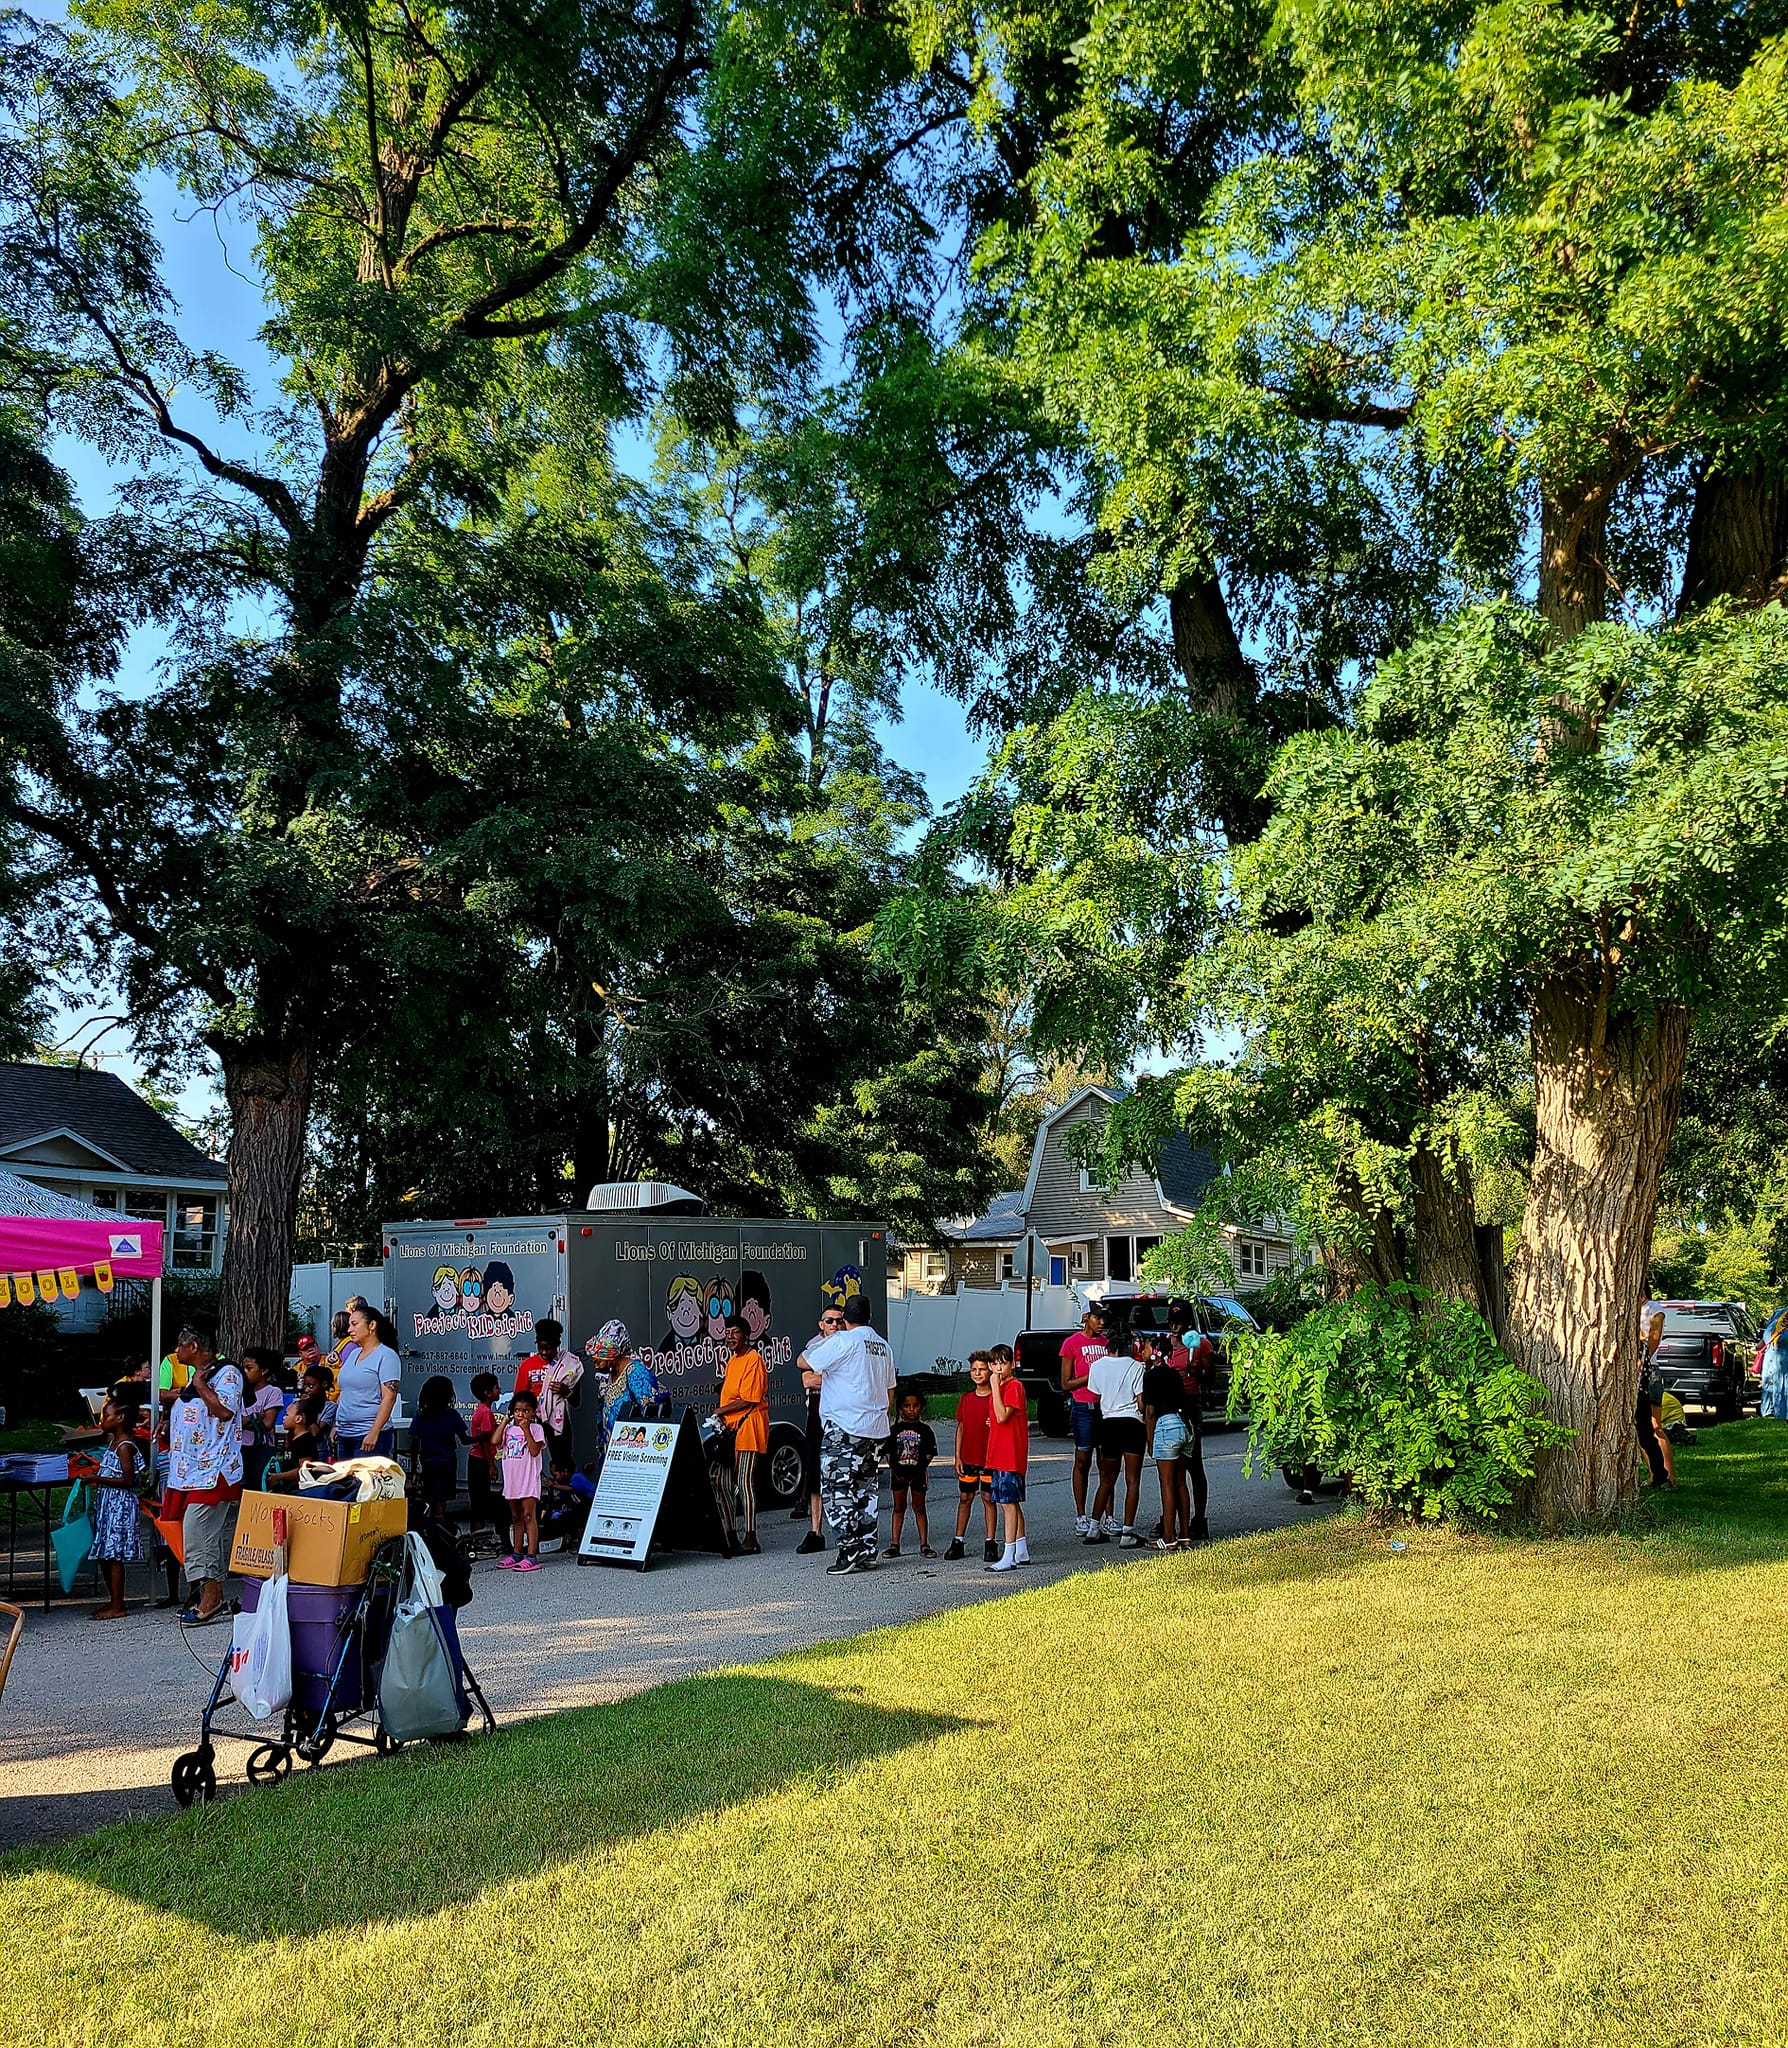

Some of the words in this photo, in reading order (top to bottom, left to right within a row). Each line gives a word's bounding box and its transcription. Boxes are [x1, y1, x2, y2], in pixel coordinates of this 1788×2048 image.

[400, 1244, 426, 1258] Lions
[428, 1244, 440, 1257] Of
[442, 1244, 486, 1259] Michigan
[490, 1240, 548, 1256] Foundation
[615, 1241, 656, 1261] Lions
[658, 1241, 676, 1260] Of
[678, 1241, 738, 1263] Michigan
[741, 1241, 807, 1261] Foundation
[413, 1309, 466, 1339] Project
[467, 1310, 534, 1340] KIDsight
[638, 1336, 714, 1376] Project
[714, 1335, 793, 1378] Kight
[407, 1363, 425, 1373] Free
[426, 1363, 448, 1373] Vision
[450, 1362, 489, 1374] Screening
[491, 1362, 506, 1374] For
[606, 1449, 623, 1461] FREE
[623, 1450, 640, 1463] Vision
[640, 1452, 668, 1467] Screening
[295, 1504, 336, 1532] Socks
